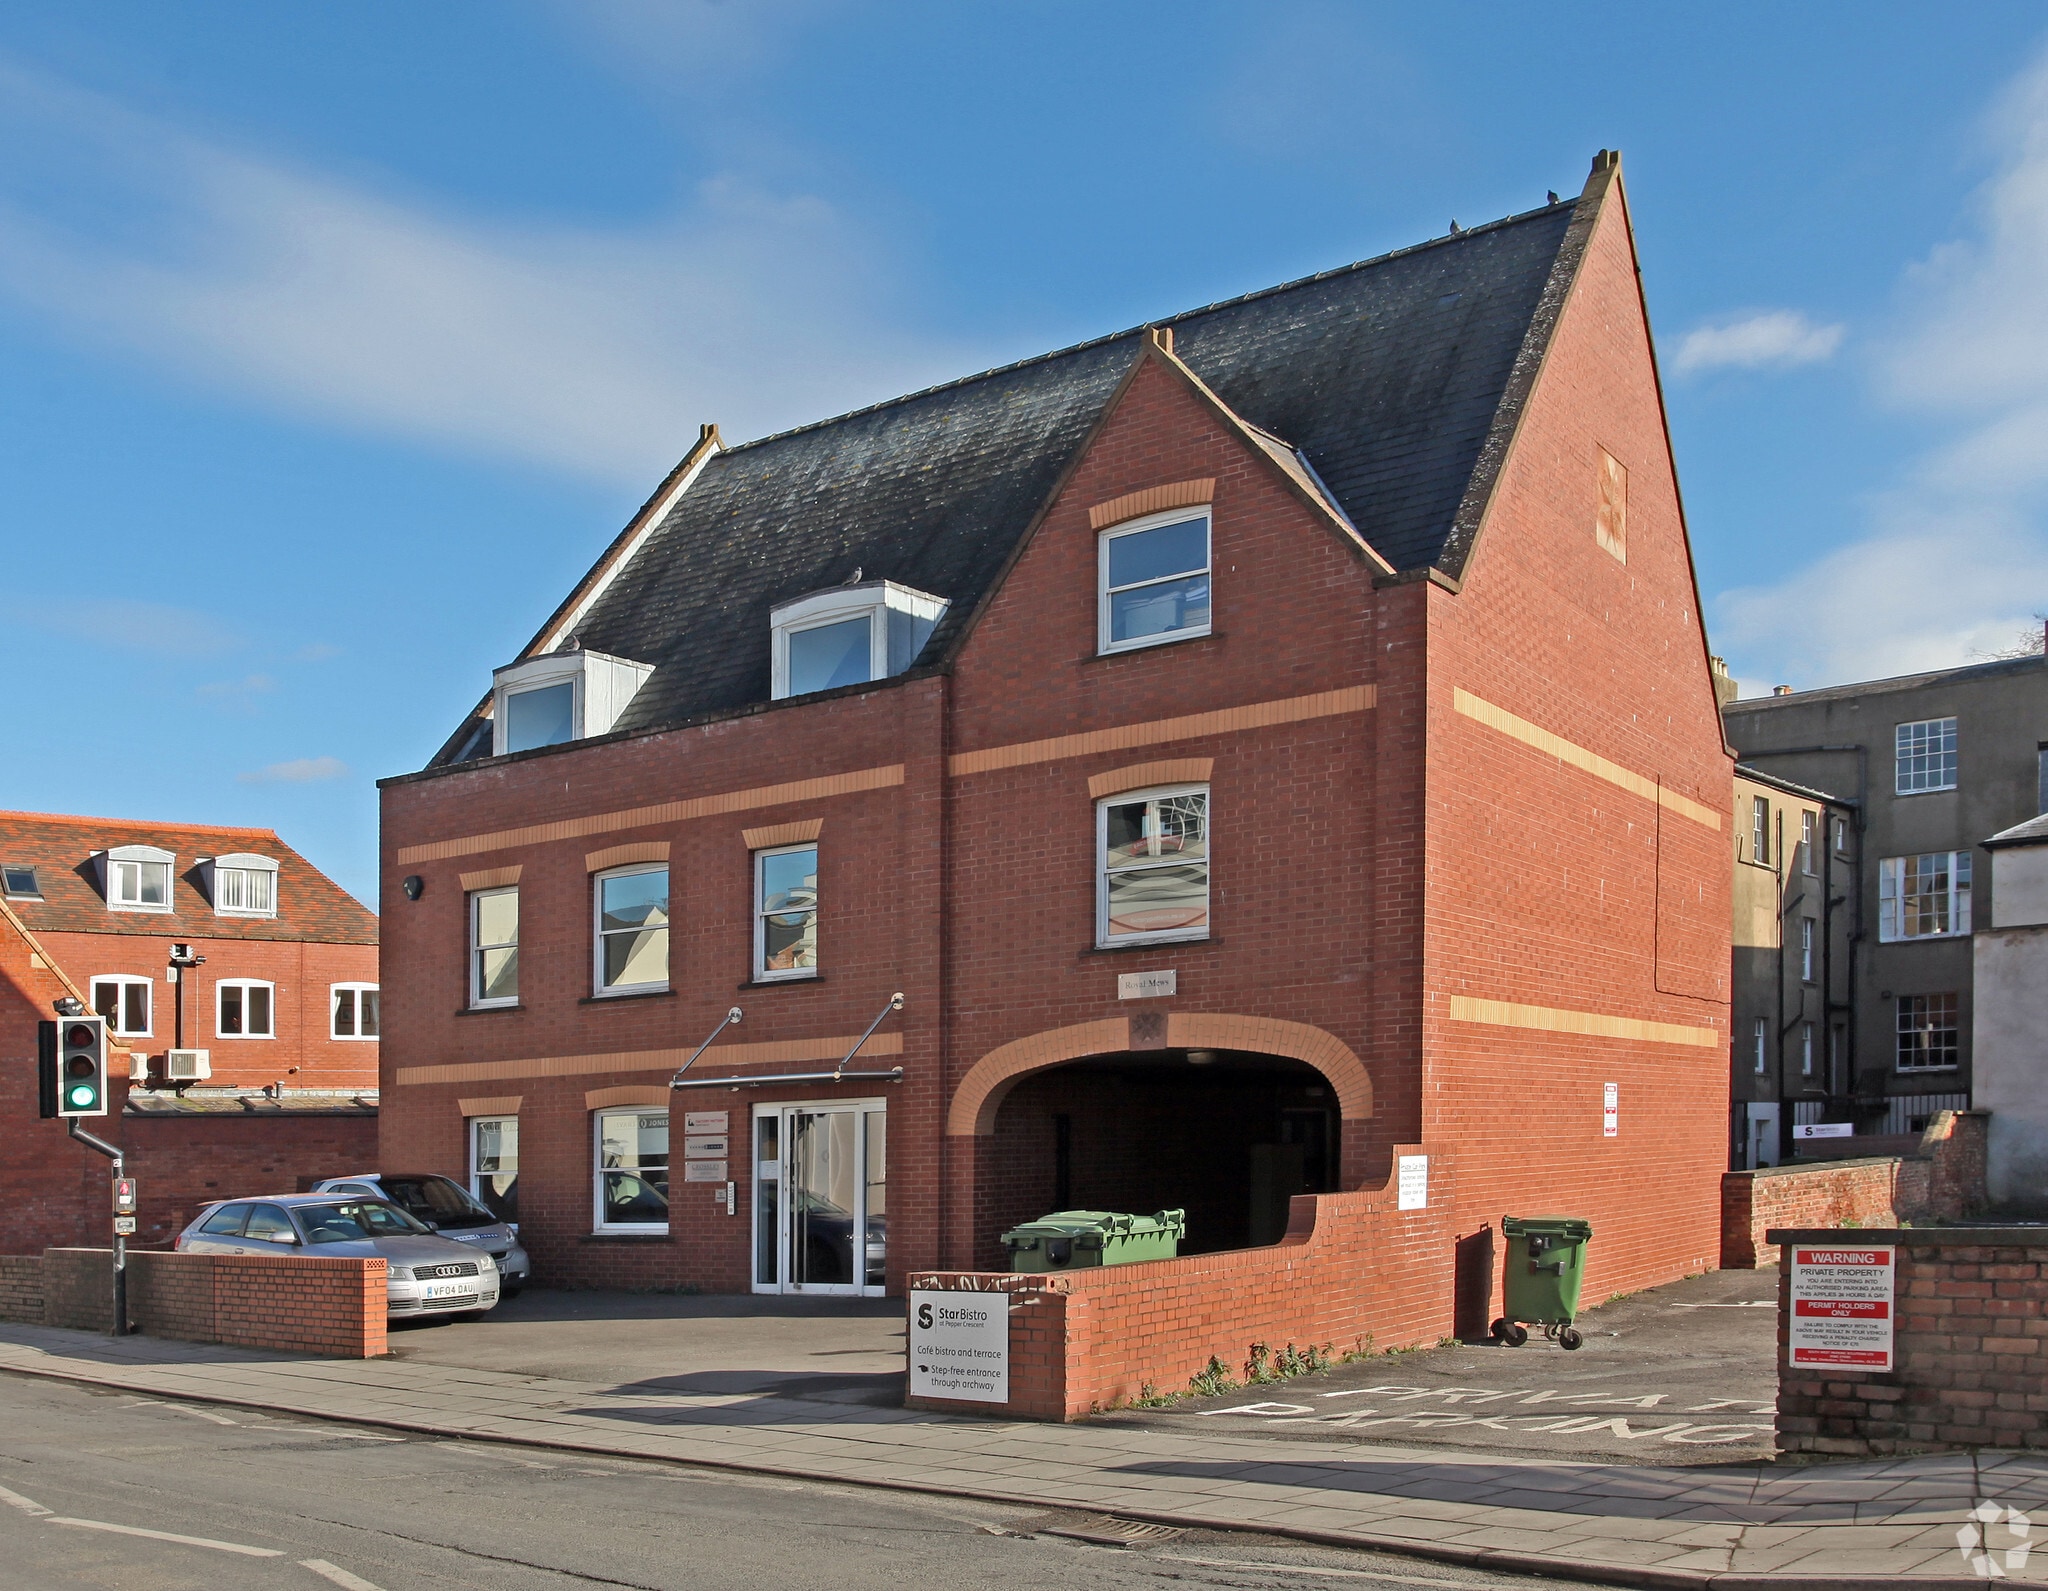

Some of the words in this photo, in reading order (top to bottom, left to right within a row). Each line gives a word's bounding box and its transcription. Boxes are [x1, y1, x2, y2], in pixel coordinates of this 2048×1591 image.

[1125, 980, 1146, 989] Royal
[1148, 979, 1169, 987] Mews
[648, 1119, 669, 1127] JONES
[1811, 1252, 1875, 1264] WARNING
[1800, 1268, 1834, 1276] PRIVATE
[1837, 1268, 1885, 1277] PROPERTY
[433, 1286, 456, 1296] VF04
[458, 1284, 473, 1294] DAU
[1808, 1301, 1836, 1309] PERMIT
[1838, 1302, 1875, 1310] HOLDERS
[939, 1308, 987, 1321] StarBistro
[945, 1320, 962, 1328] Pepper
[917, 1345, 933, 1355] Café
[935, 1346, 956, 1356] bistro
[957, 1348, 972, 1357] and
[974, 1349, 1001, 1359] terrace
[931, 1365, 965, 1376] Step-free
[966, 1368, 1001, 1378] entrance
[931, 1377, 960, 1389] through
[962, 1380, 995, 1392] archway
[1317, 1386, 1777, 1414] PRIVAT
[1195, 1400, 1777, 1444] PARKING
